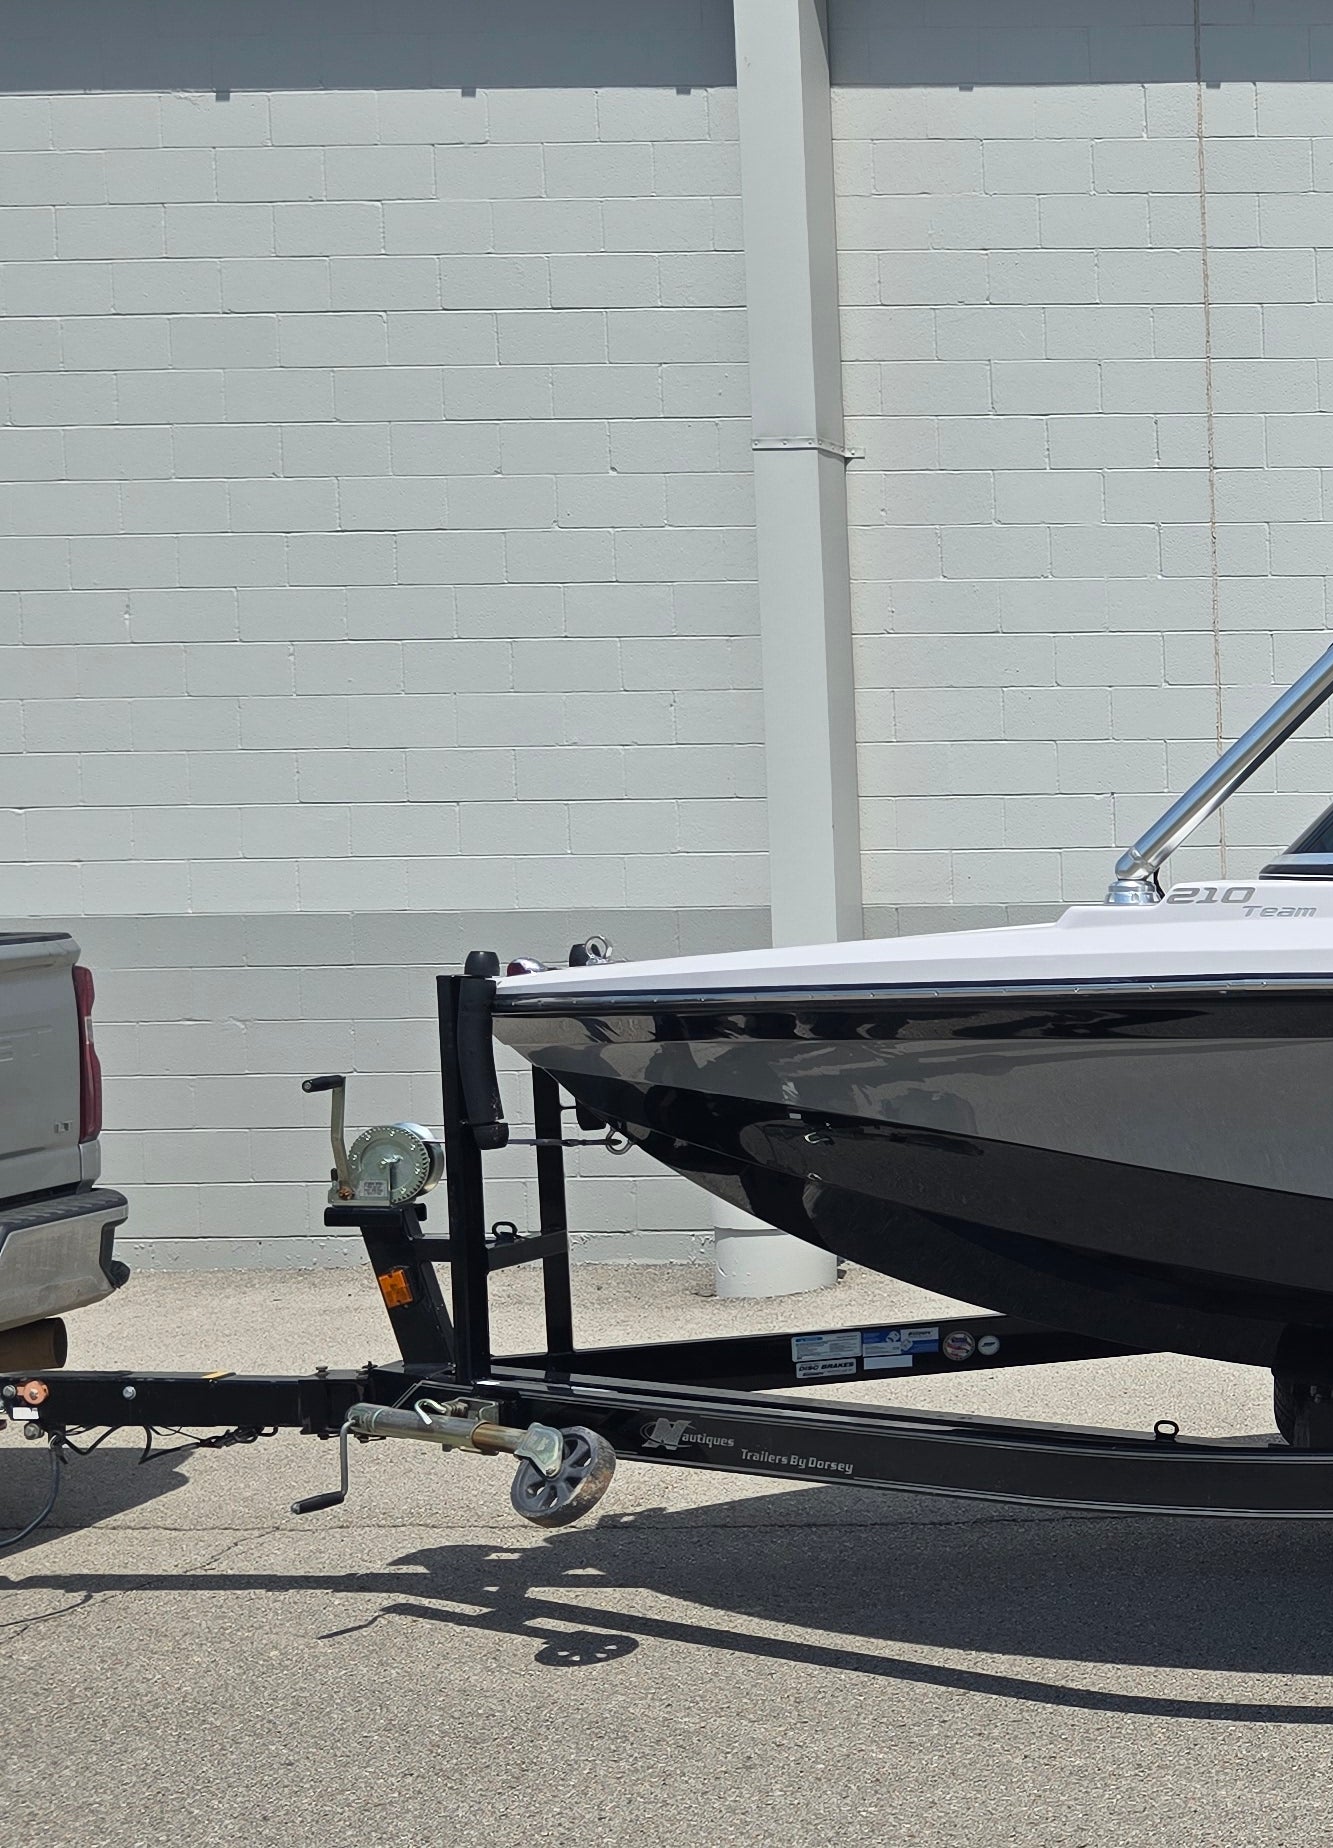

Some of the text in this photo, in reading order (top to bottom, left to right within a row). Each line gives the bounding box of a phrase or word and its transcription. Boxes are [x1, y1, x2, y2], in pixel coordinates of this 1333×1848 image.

[1166, 887, 1256, 904] 210
[1242, 905, 1317, 918] Team
[640, 1417, 735, 1450] Nautiques
[741, 1449, 854, 1475] Trailers By Dorsey
